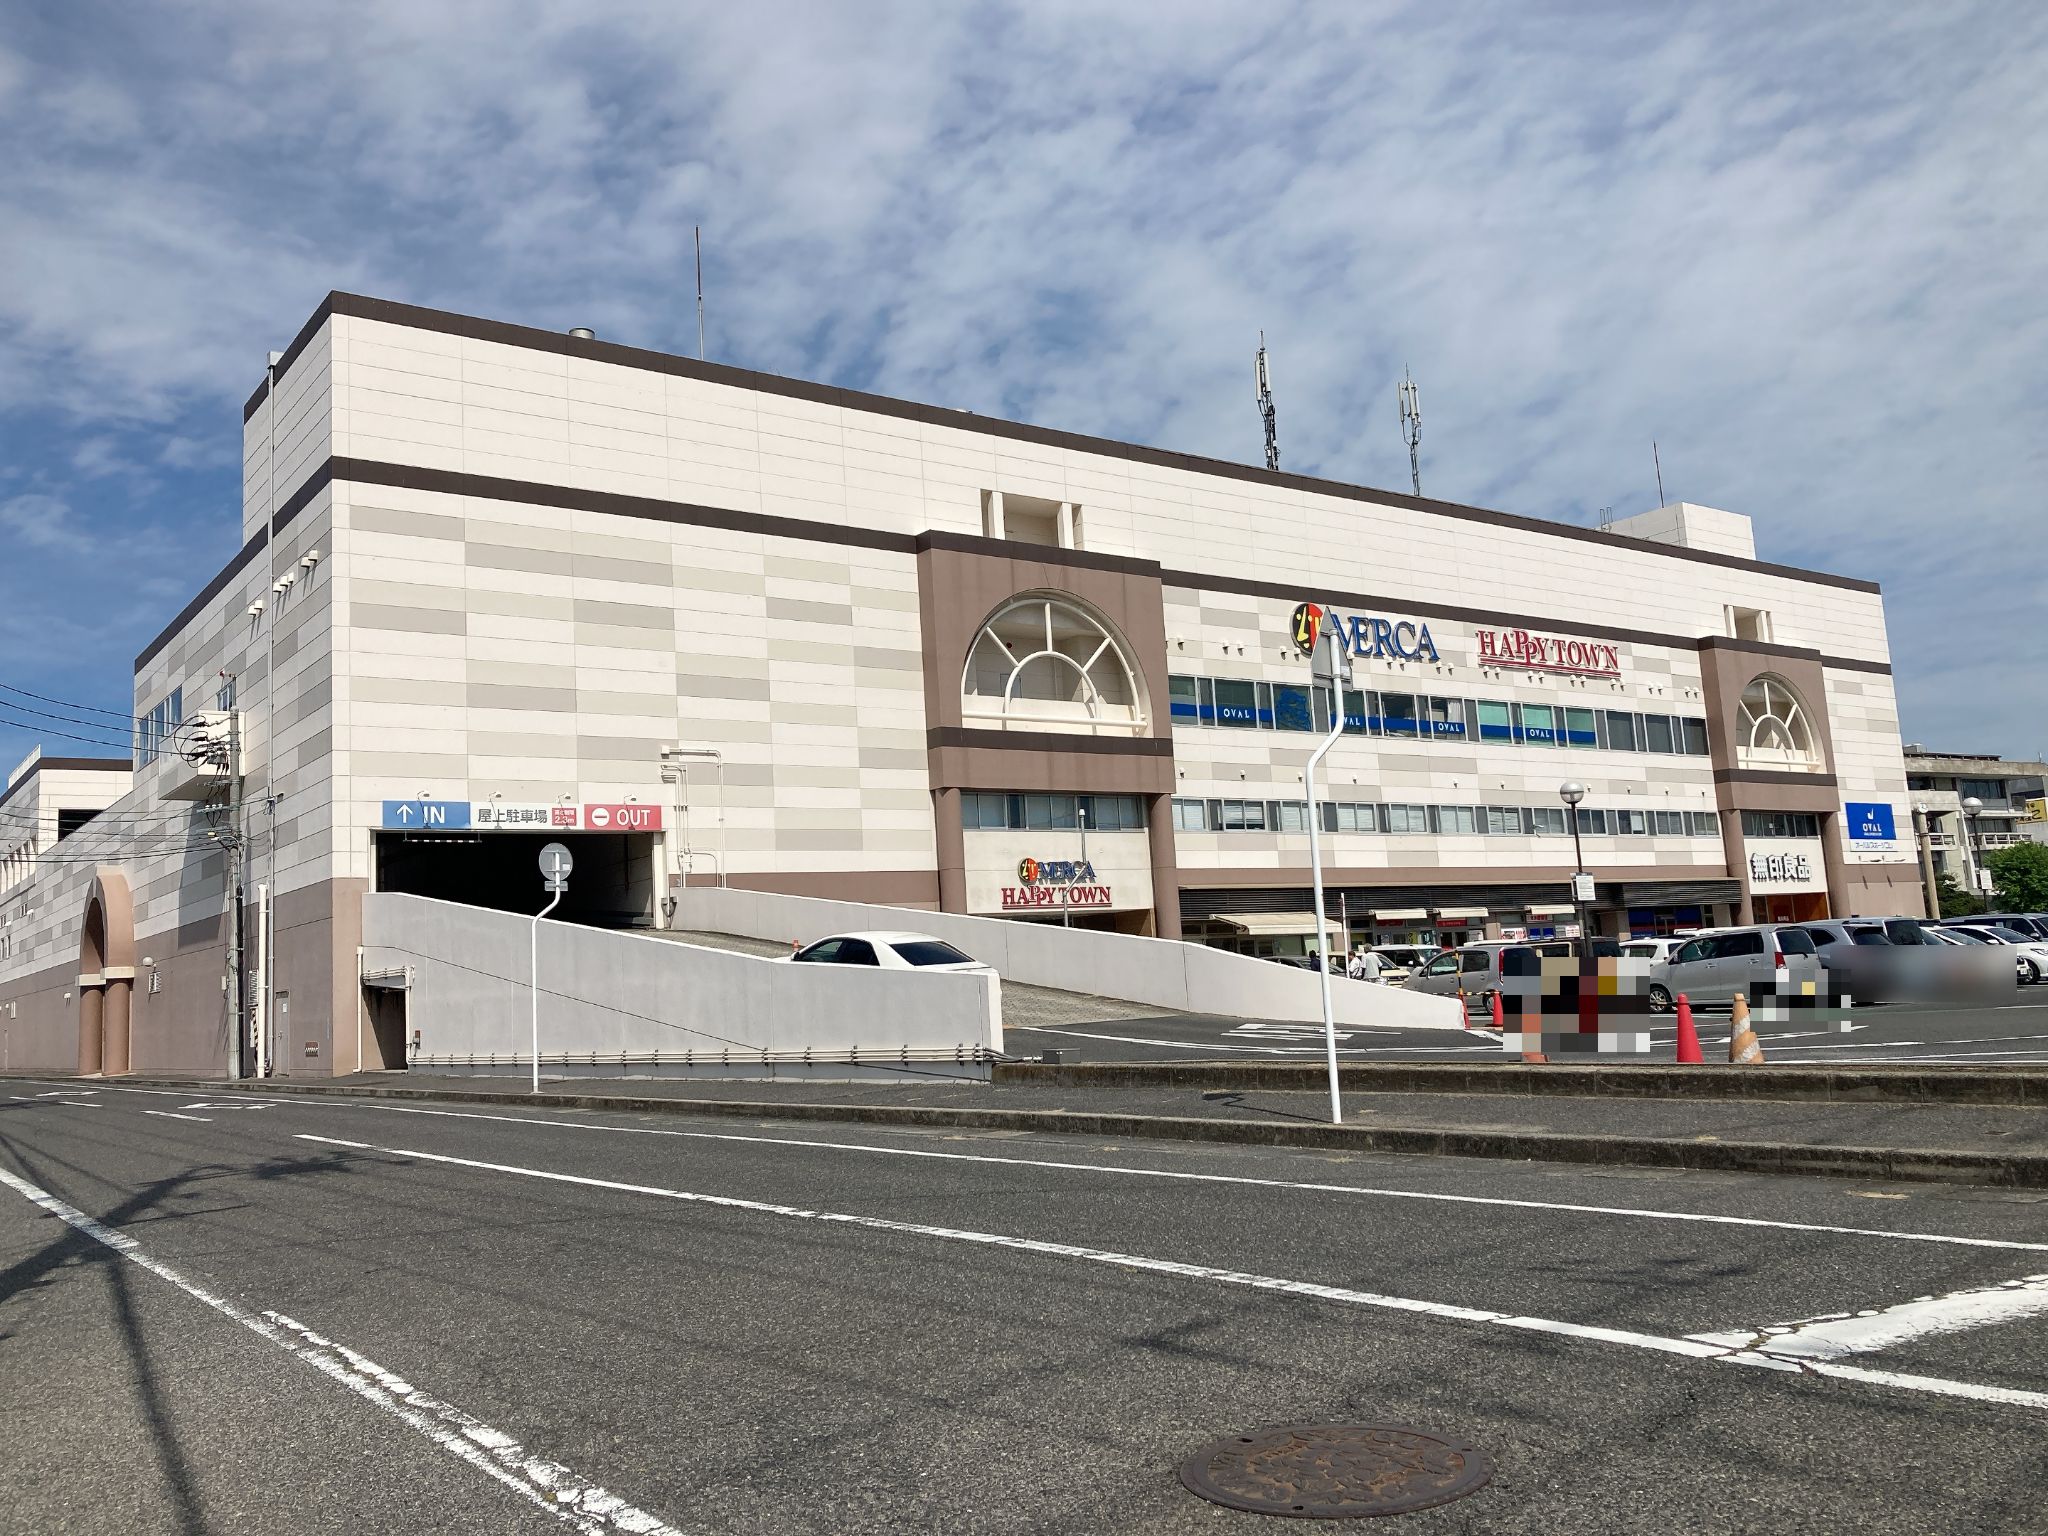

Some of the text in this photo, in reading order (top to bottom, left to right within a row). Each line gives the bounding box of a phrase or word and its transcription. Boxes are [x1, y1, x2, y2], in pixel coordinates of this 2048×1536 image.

[1477, 629, 1618, 671] HAPPY TOWN
[1223, 708, 1250, 719] OVAL
[1438, 722, 1460, 732] OVAL
[1529, 729, 1550, 738] OVAL
[423, 806, 445, 824] IN
[477, 808, 548, 824] 屋上駐車場
[616, 808, 651, 826] OUT
[1862, 823, 1882, 832] OVAL
[1751, 852, 1812, 880] 無印良品
[1001, 885, 1111, 905] HAPPY TOWN
